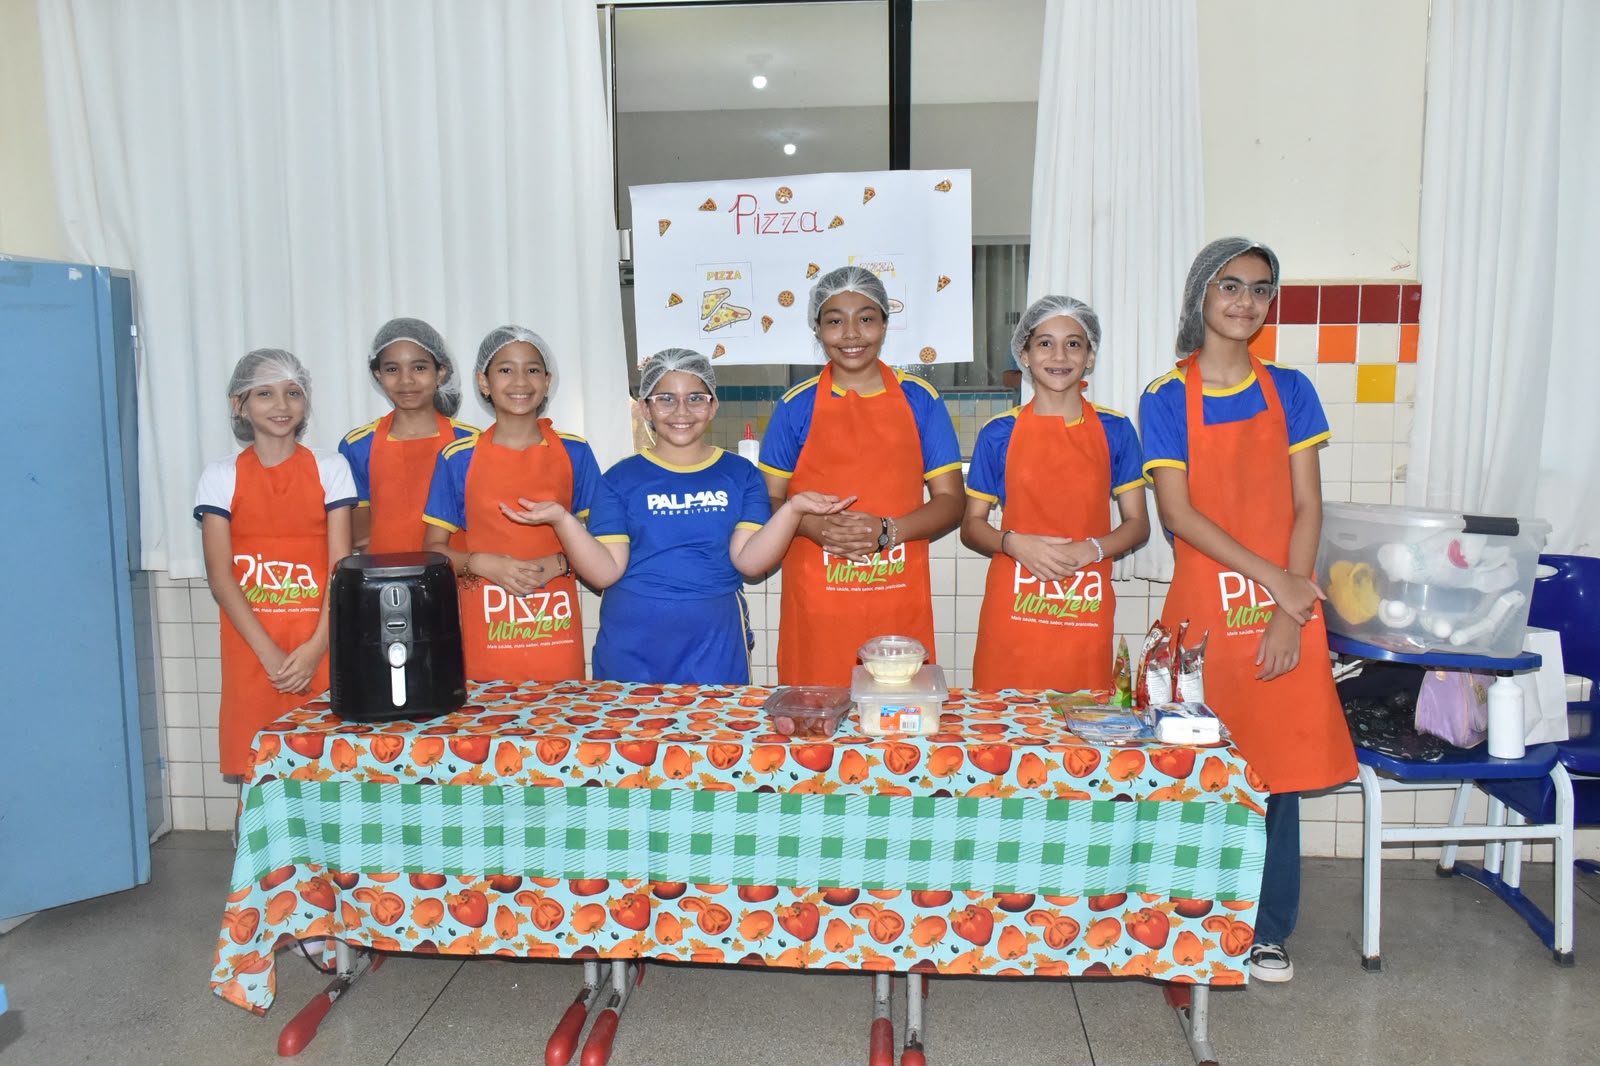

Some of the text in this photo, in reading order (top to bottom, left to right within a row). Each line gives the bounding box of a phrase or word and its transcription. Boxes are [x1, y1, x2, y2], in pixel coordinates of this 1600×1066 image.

[728, 194, 824, 235] Pizza
[706, 270, 742, 281] PIZZA
[647, 490, 729, 510] PALMAS
[652, 507, 726, 516] PREFEITURA
[483, 585, 572, 624] Pizza
